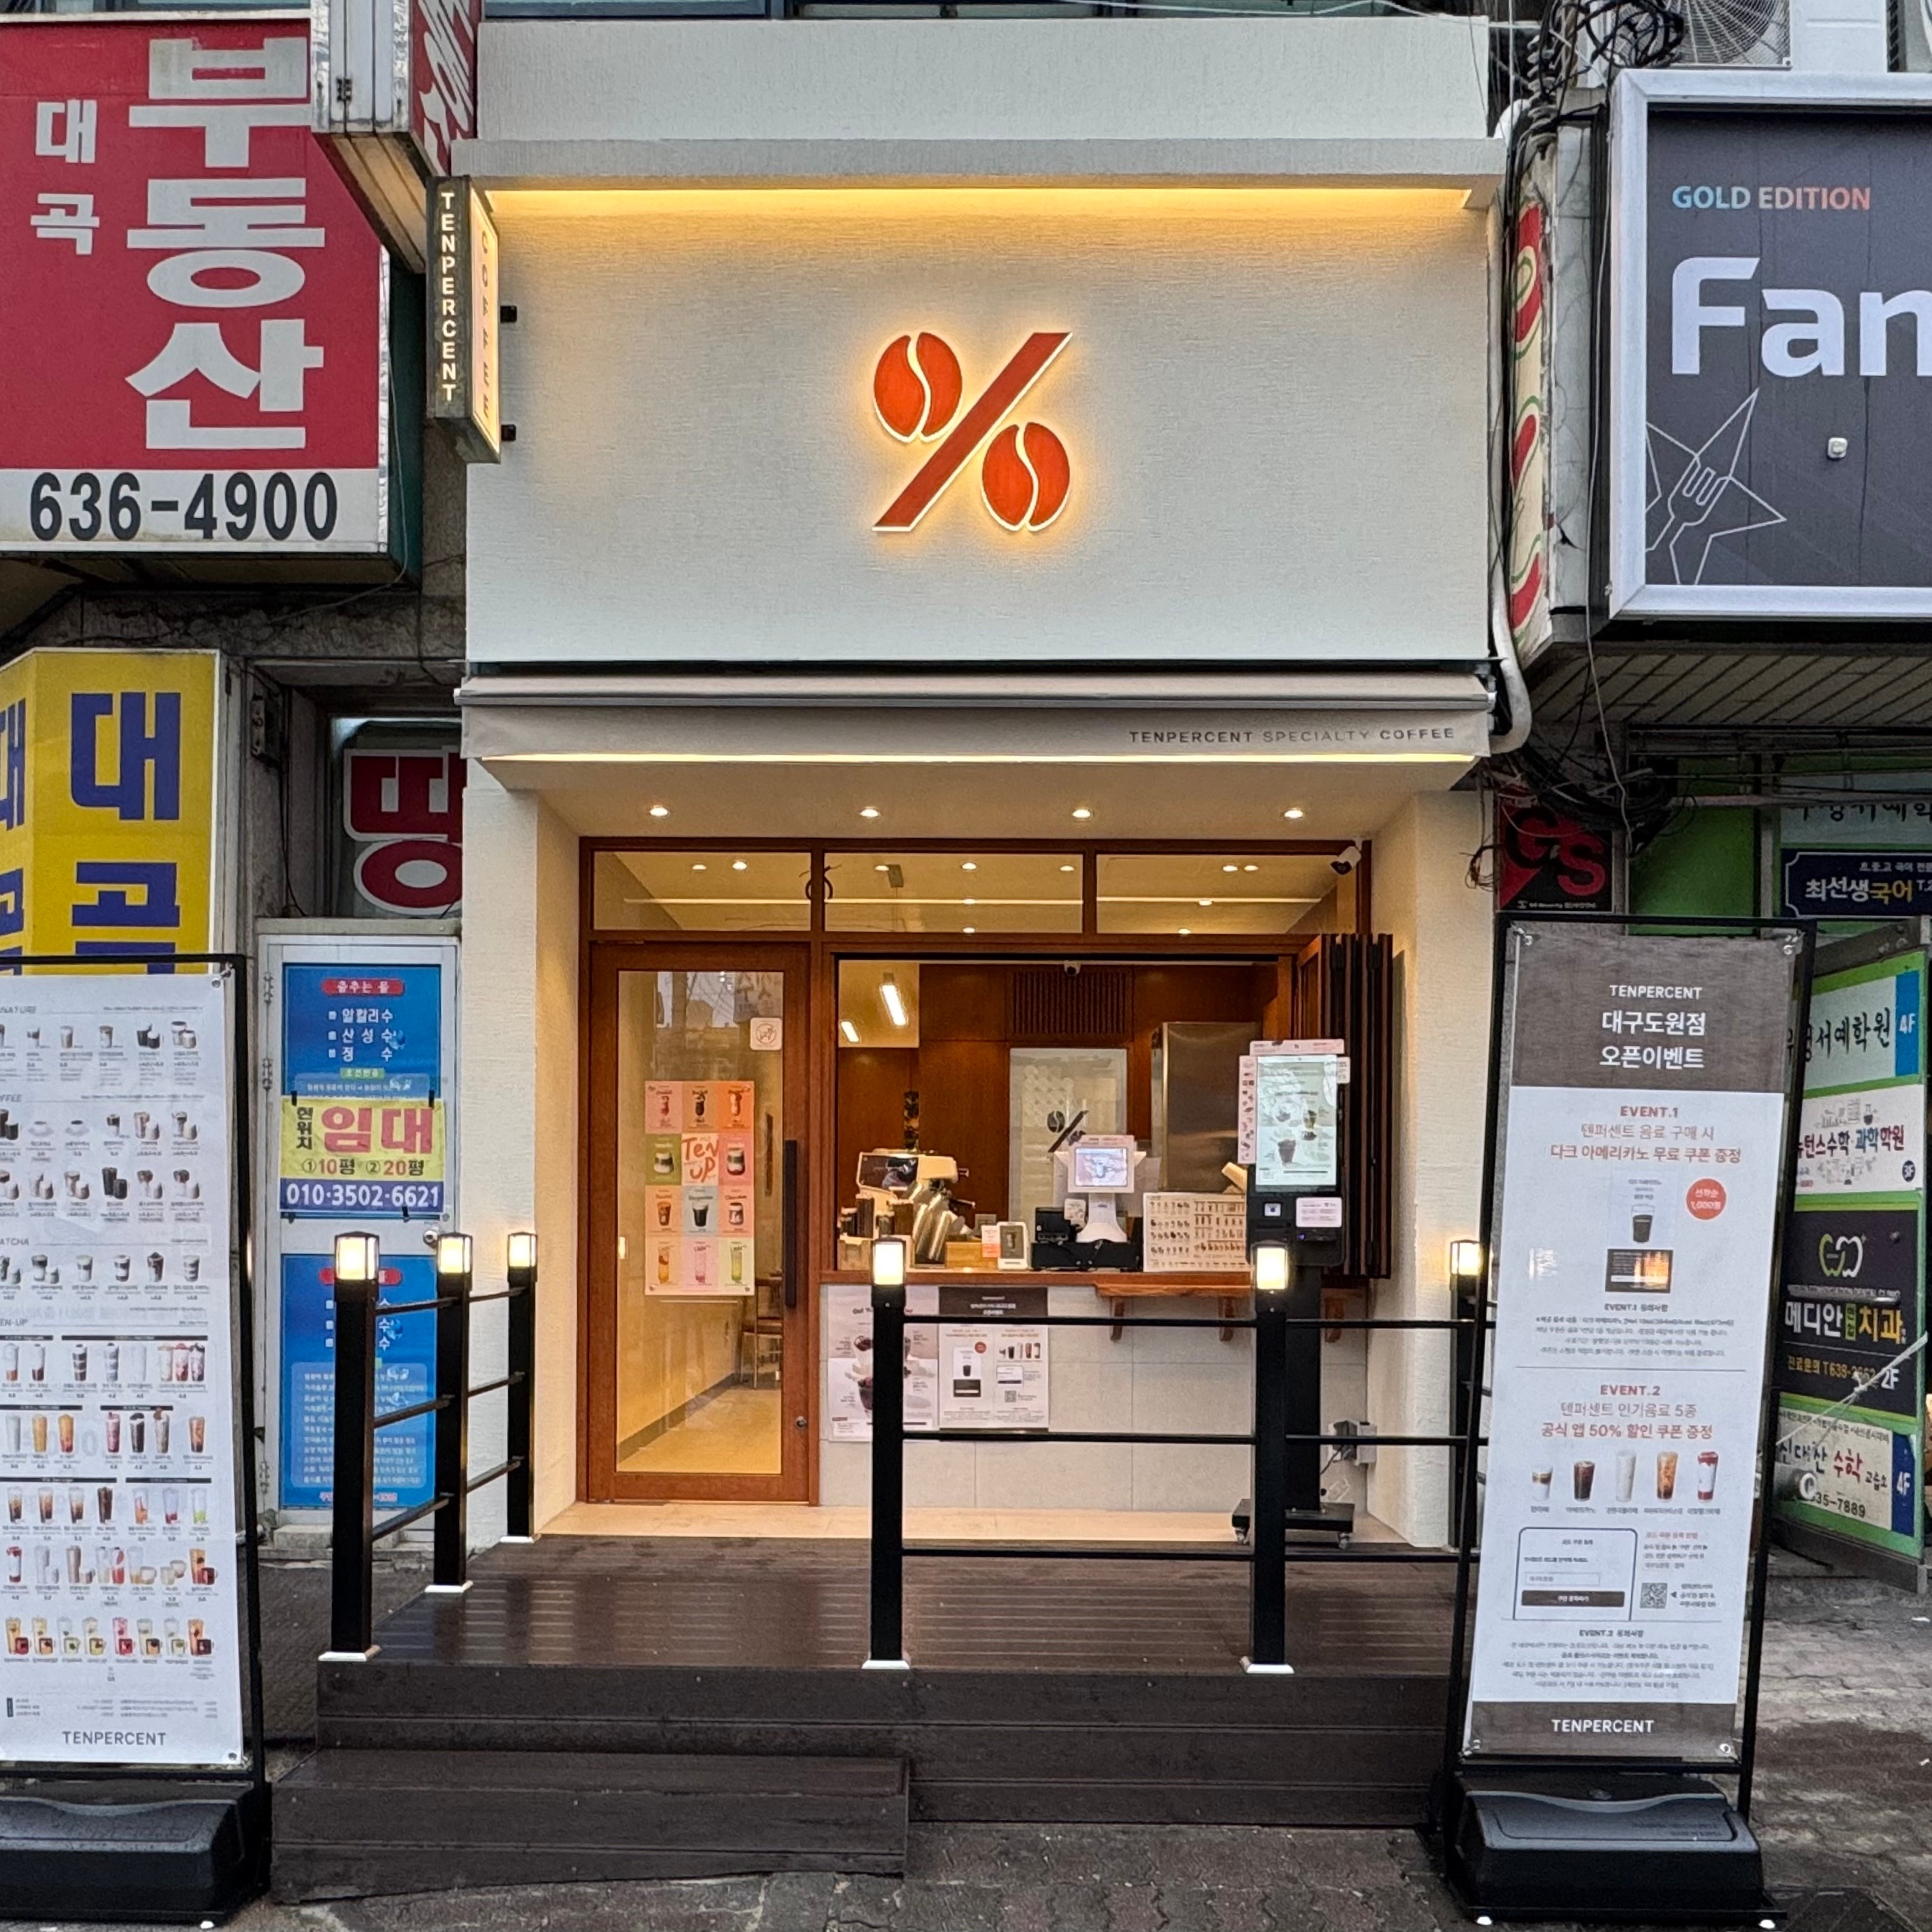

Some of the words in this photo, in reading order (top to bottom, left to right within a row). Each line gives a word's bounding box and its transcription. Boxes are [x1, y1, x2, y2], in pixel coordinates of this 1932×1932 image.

[30, 99, 99, 255] 대곡
[1673, 185, 1751, 210] GOLD
[1759, 186, 1871, 210] EDITION
[125, 37, 325, 449] 부동산
[440, 192, 457, 402] TENPERCENT
[30, 471, 338, 541] 636-4900
[1129, 731, 1252, 744] TENPERCENT
[1263, 729, 1370, 743] SPECIALTY
[1379, 728, 1454, 740] COFFEE
[1805, 876, 1913, 905] 최선생국어
[1609, 984, 1704, 999] TENPERCENT
[1601, 1009, 1706, 1036] 대구도원점
[1899, 1013, 1916, 1034] 4F
[1599, 1045, 1704, 1070] 오픈이벤트
[1619, 1105, 1678, 1118] EVENT.1
[321, 1106, 434, 1154] 임대
[1639, 1124, 1666, 1140] 음료
[1670, 1125, 1697, 1141] 구매
[1701, 1126, 1715, 1141] 시
[1550, 1144, 1578, 1160] 다크
[1581, 1145, 1649, 1160] 아메리카노
[1653, 1147, 1680, 1162] 무료
[1683, 1147, 1711, 1163] 쿠폰
[1715, 1147, 1742, 1164] 증정
[1785, 1300, 1844, 1339] 메디안
[1858, 1305, 1903, 1345] 치과
[1600, 1384, 1661, 1396] EVENT.2
[1617, 1402, 1671, 1418] 인기음료
[1542, 1422, 1568, 1438] 공식
[1572, 1423, 1585, 1438] 앱
[1589, 1423, 1622, 1438] 50%
[1626, 1423, 1653, 1439] 할인
[1657, 1424, 1683, 1439] 쿠폰
[1686, 1424, 1713, 1440] 증정
[1833, 1448, 1863, 1484] 수학
[63, 1730, 167, 1746] TENPERCENT
[1551, 1719, 1655, 1734] TENPERCENT
